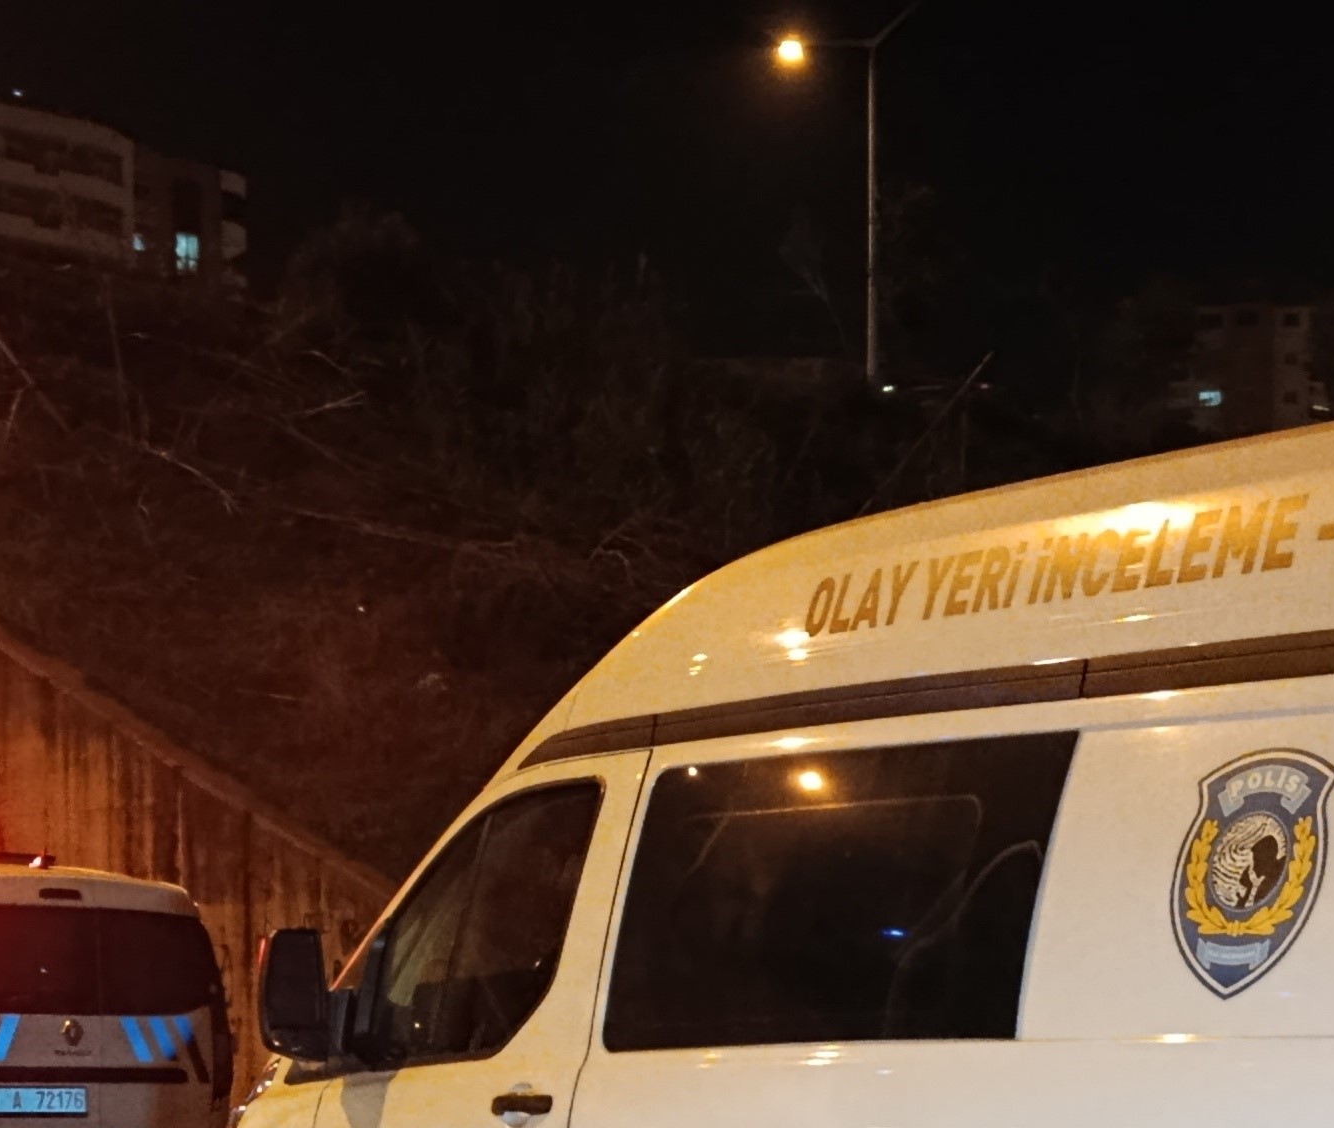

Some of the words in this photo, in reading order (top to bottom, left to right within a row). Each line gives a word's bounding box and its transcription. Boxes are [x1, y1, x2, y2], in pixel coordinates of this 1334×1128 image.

[805, 560, 919, 637] OLAY
[13, 1091, 22, 1109] A
[36, 1090, 84, 1110] 72176
